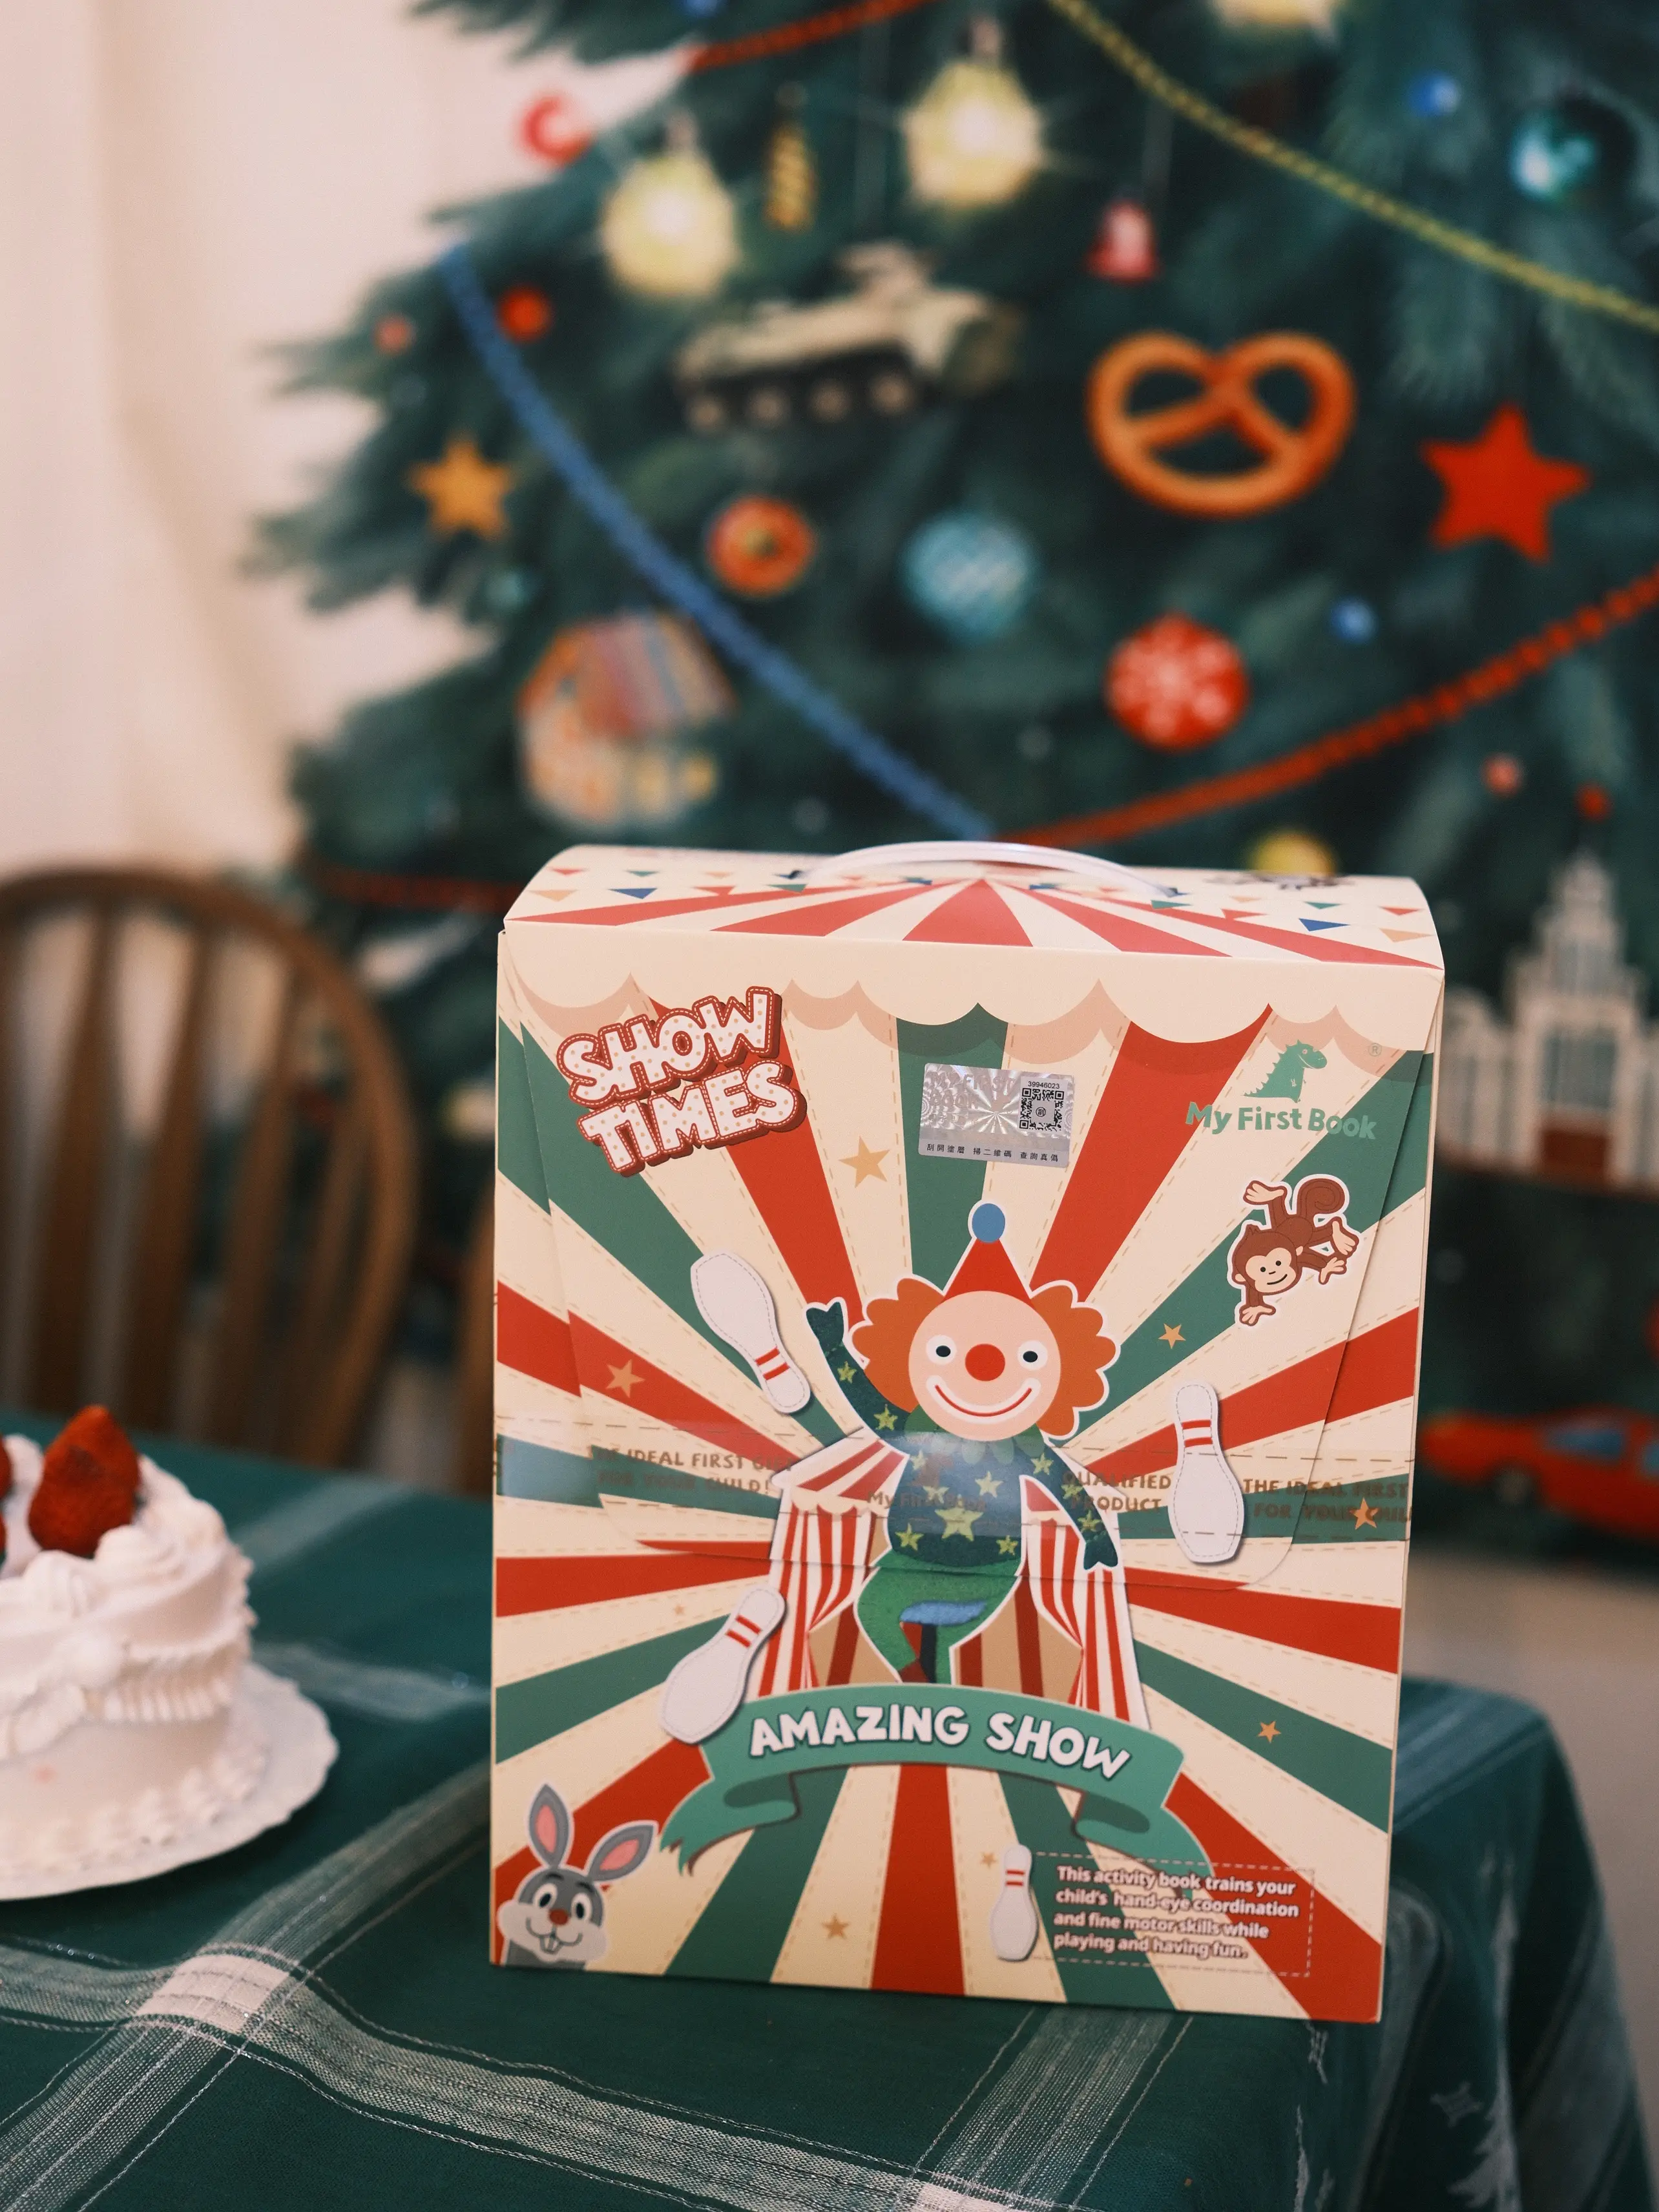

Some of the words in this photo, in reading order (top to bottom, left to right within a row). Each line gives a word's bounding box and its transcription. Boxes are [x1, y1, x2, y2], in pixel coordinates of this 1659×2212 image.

[558, 986, 782, 1108] SHOW
[1028, 1081, 1060, 1089] 39946023
[577, 1060, 806, 1176] TIMES
[1185, 1101, 1232, 1134] My
[1238, 1106, 1302, 1131] First
[1308, 1107, 1377, 1140] Book
[627, 1449, 684, 1466] IDEAL
[691, 1453, 746, 1470] FIRST
[1061, 1471, 1172, 1489] QUALIFIED
[1243, 1478, 1280, 1494] THE
[1286, 1480, 1347, 1496] IDEAL
[868, 1491, 892, 1508] My
[1069, 1494, 1163, 1510] PRODUCT
[1253, 1503, 1291, 1518] FOR
[750, 1704, 970, 1757] AMAZING
[985, 1711, 1132, 1779] SHOW
[1057, 1865, 1092, 1883] This
[1093, 1869, 1156, 1890] activity
[1158, 1871, 1201, 1889] book
[1205, 1875, 1255, 1893] trains
[1256, 1881, 1297, 1897] your
[1113, 1890, 1191, 1914] hand-eye
[1193, 1897, 1300, 1917] coordination
[1053, 1910, 1087, 1927] and
[1088, 1911, 1122, 1929] fine
[1123, 1917, 1176, 1932] motor
[1177, 1917, 1220, 1936] skills
[1222, 1921, 1270, 1939] while
[1054, 1931, 1116, 1954] playing
[1117, 1936, 1149, 1952] and
[1151, 1936, 1209, 1960] having
[1211, 1940, 1249, 1959] fun.
